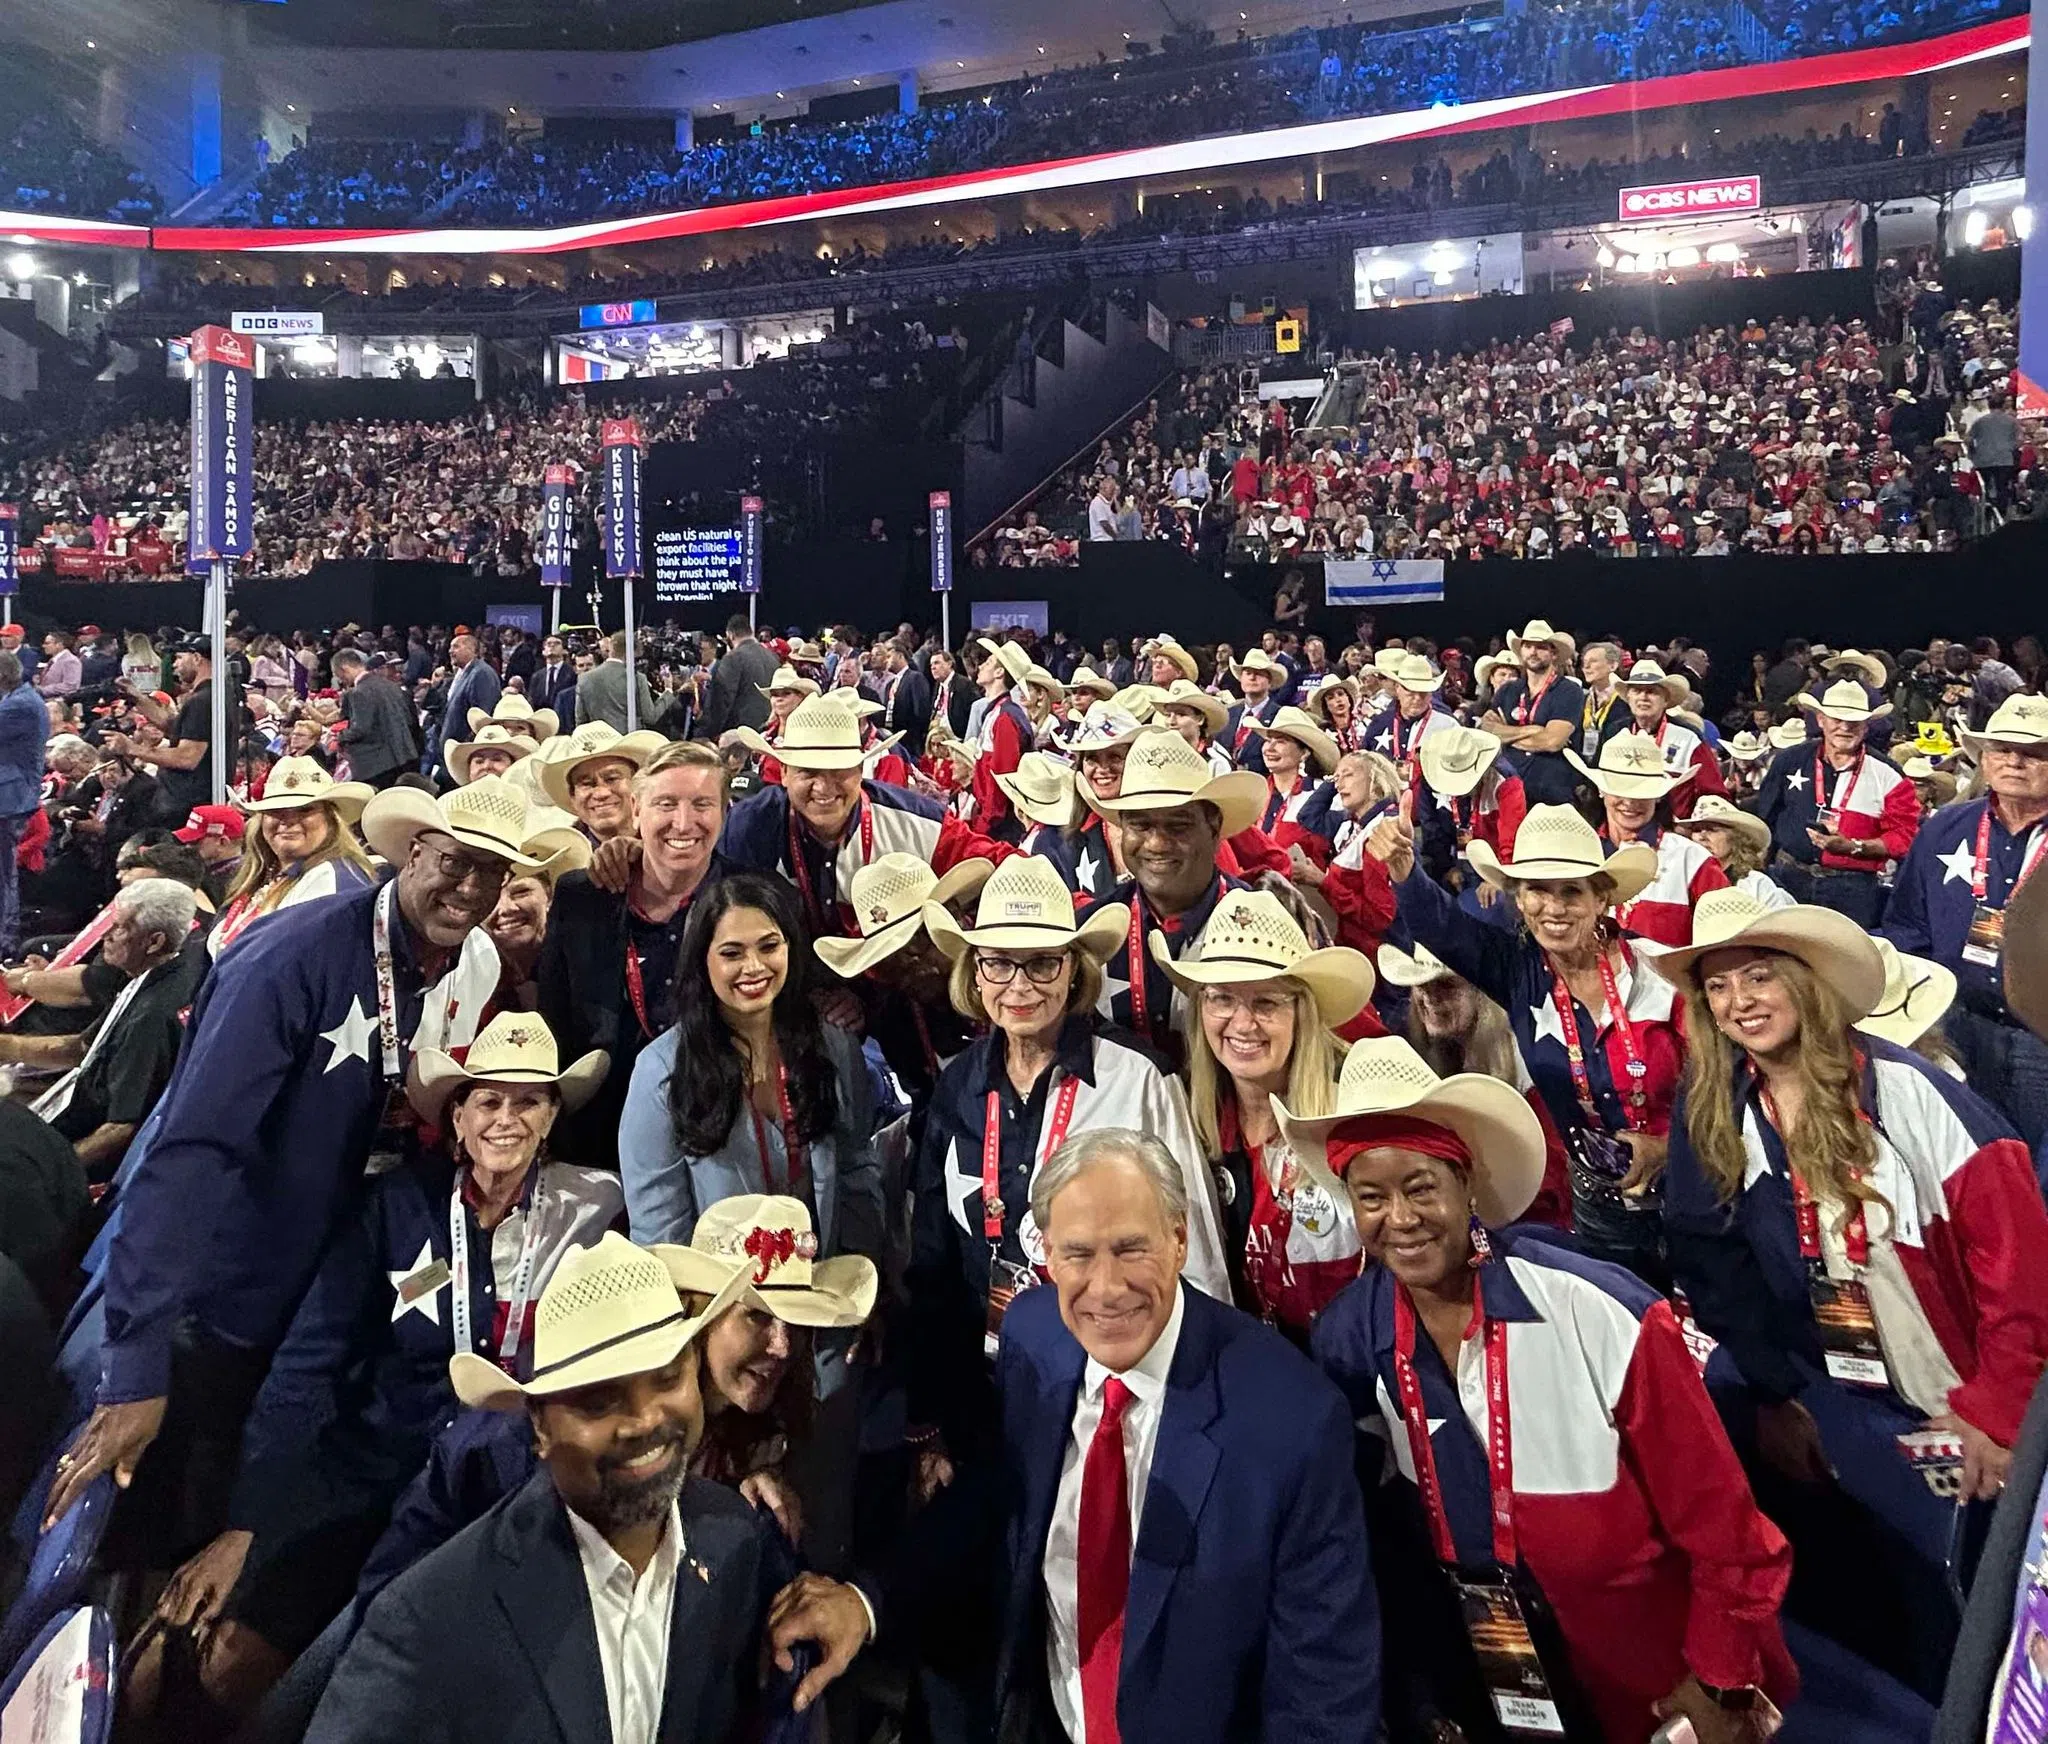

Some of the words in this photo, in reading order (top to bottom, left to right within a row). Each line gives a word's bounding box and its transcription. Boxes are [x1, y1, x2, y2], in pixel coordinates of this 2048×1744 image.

[1643, 189, 1686, 210] CBS
[1687, 183, 1753, 207] NEWS
[242, 318, 279, 329] BBC
[281, 319, 314, 329] NEWS
[603, 302, 633, 323] CNN
[224, 369, 238, 475] AMERICAN
[225, 480, 238, 547] SAMOA
[611, 448, 625, 568] KENTUCKY
[632, 448, 641, 568] KENTUCKY
[935, 508, 945, 535] NEW
[545, 495, 560, 566] GUAM
[562, 496, 573, 567] GUAM
[656, 531, 682, 543] clean
[683, 530, 697, 541] US
[698, 529, 733, 541] natural
[746, 513, 755, 556] PUERTO
[656, 544, 687, 556] export
[656, 556, 681, 567] think
[682, 555, 709, 566] about
[710, 555, 727, 566] the
[937, 534, 945, 586] JERSEY
[656, 569, 678, 581] they
[679, 568, 704, 579] must
[705, 567, 729, 578] have
[745, 557, 754, 587] RICO
[656, 581, 690, 592] thrown
[691, 580, 711, 591] that
[712, 579, 738, 593] night
[989, 613, 1029, 628] EXIT
